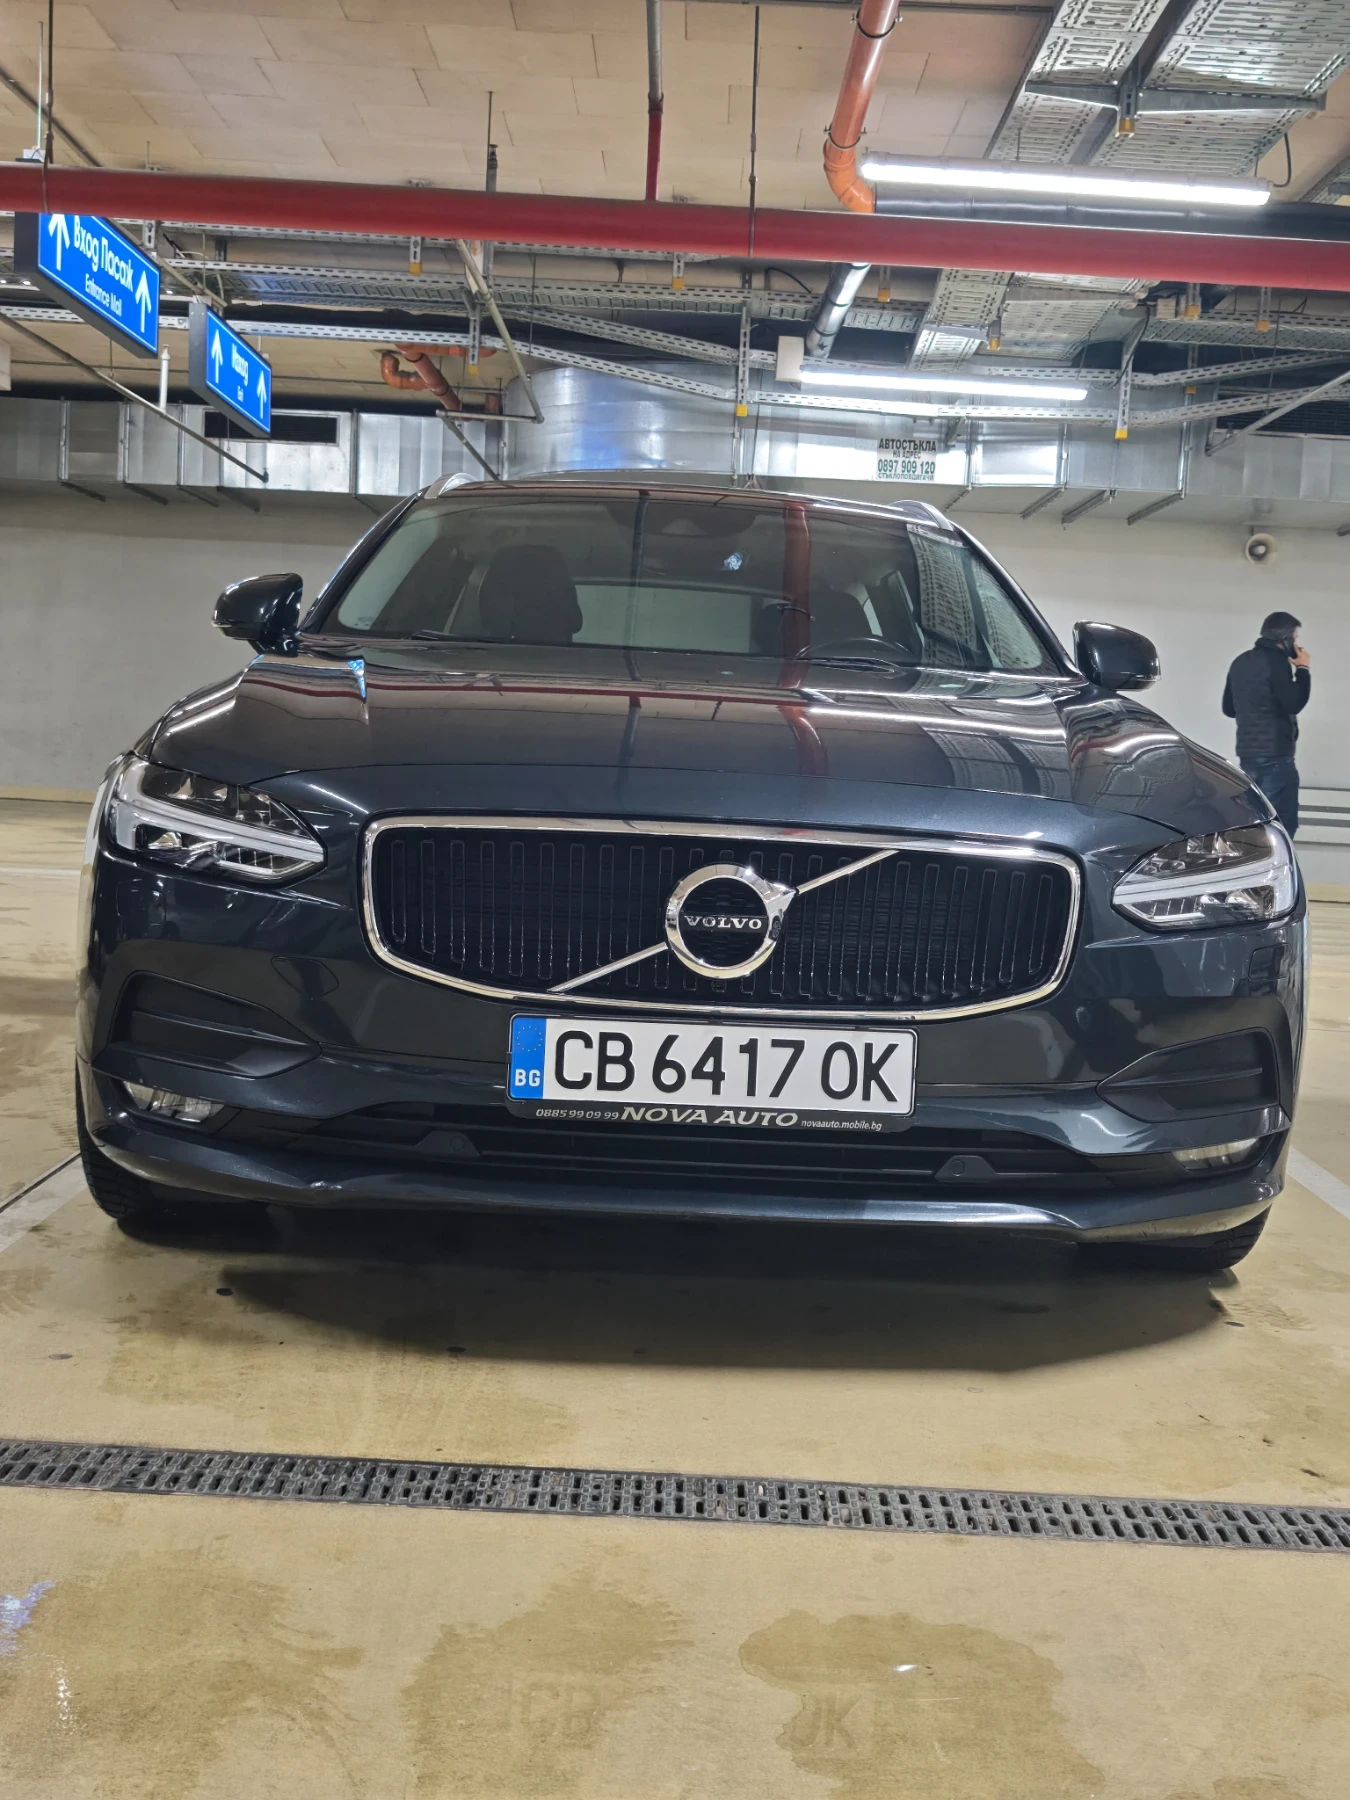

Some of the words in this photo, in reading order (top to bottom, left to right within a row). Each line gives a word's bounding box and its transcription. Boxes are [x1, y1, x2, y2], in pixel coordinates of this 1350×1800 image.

[74, 215, 99, 272] Вход
[101, 236, 133, 292] Пасаж
[85, 273, 109, 307] Entrance
[878, 438, 936, 452] АВТОСТЪКЛА
[893, 450, 900, 458] НА
[902, 451, 921, 459] АДРЕС
[878, 459, 898, 473] 0897
[901, 460, 917, 474] 909
[920, 461, 936, 475] 120
[684, 915, 762, 930] VOLVO
[555, 1030, 635, 1092] CB
[652, 1034, 806, 1098] 6417
[820, 1041, 900, 1102] OK
[514, 1069, 541, 1087] BG
[535, 1108, 567, 1118] 0885
[569, 1109, 584, 1118] 99
[586, 1111, 602, 1119] 09
[603, 1111, 619, 1120] 99
[620, 1106, 708, 1123] NOVA
[713, 1109, 799, 1127] AUTO
[801, 1120, 882, 1132] novaauto.mobile.bg
